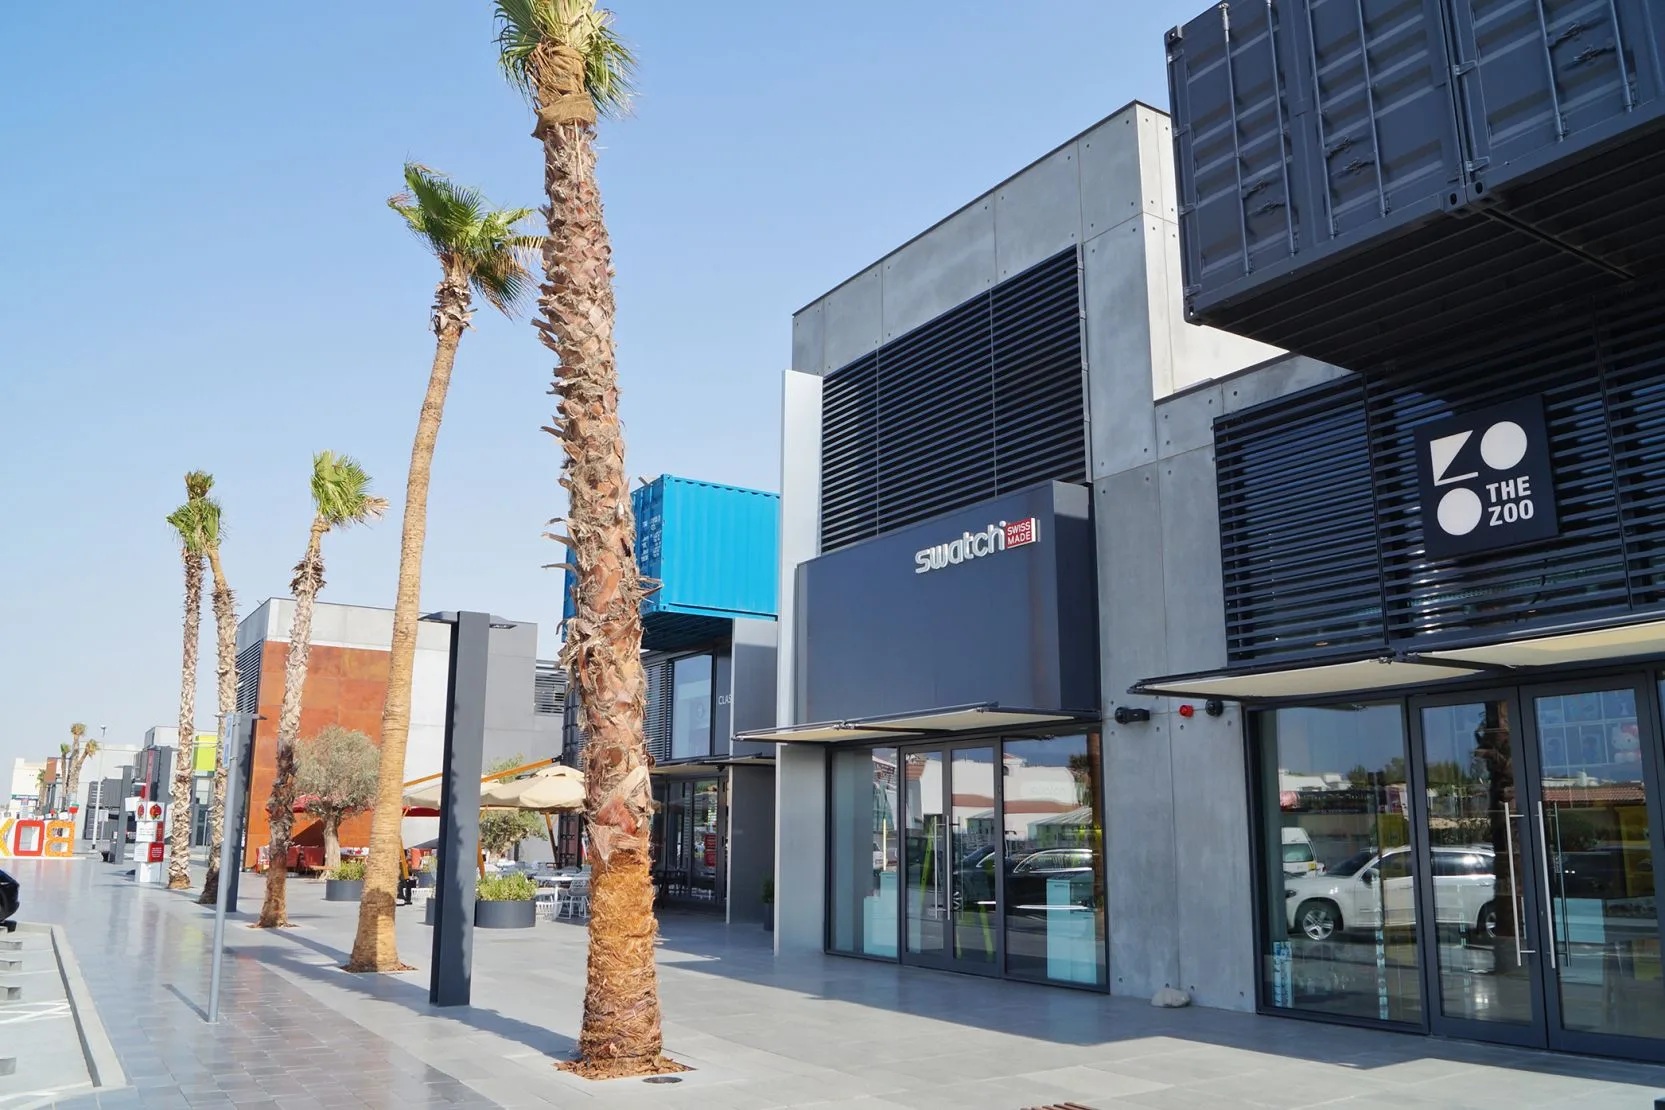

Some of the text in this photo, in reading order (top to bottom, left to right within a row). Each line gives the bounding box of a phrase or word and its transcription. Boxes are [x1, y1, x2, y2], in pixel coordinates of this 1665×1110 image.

[1486, 475, 1531, 503] THE
[1488, 499, 1534, 527] ZOO
[1007, 521, 1031, 535] SWISS
[1008, 530, 1031, 545] MADE
[915, 523, 1006, 574] swatch
